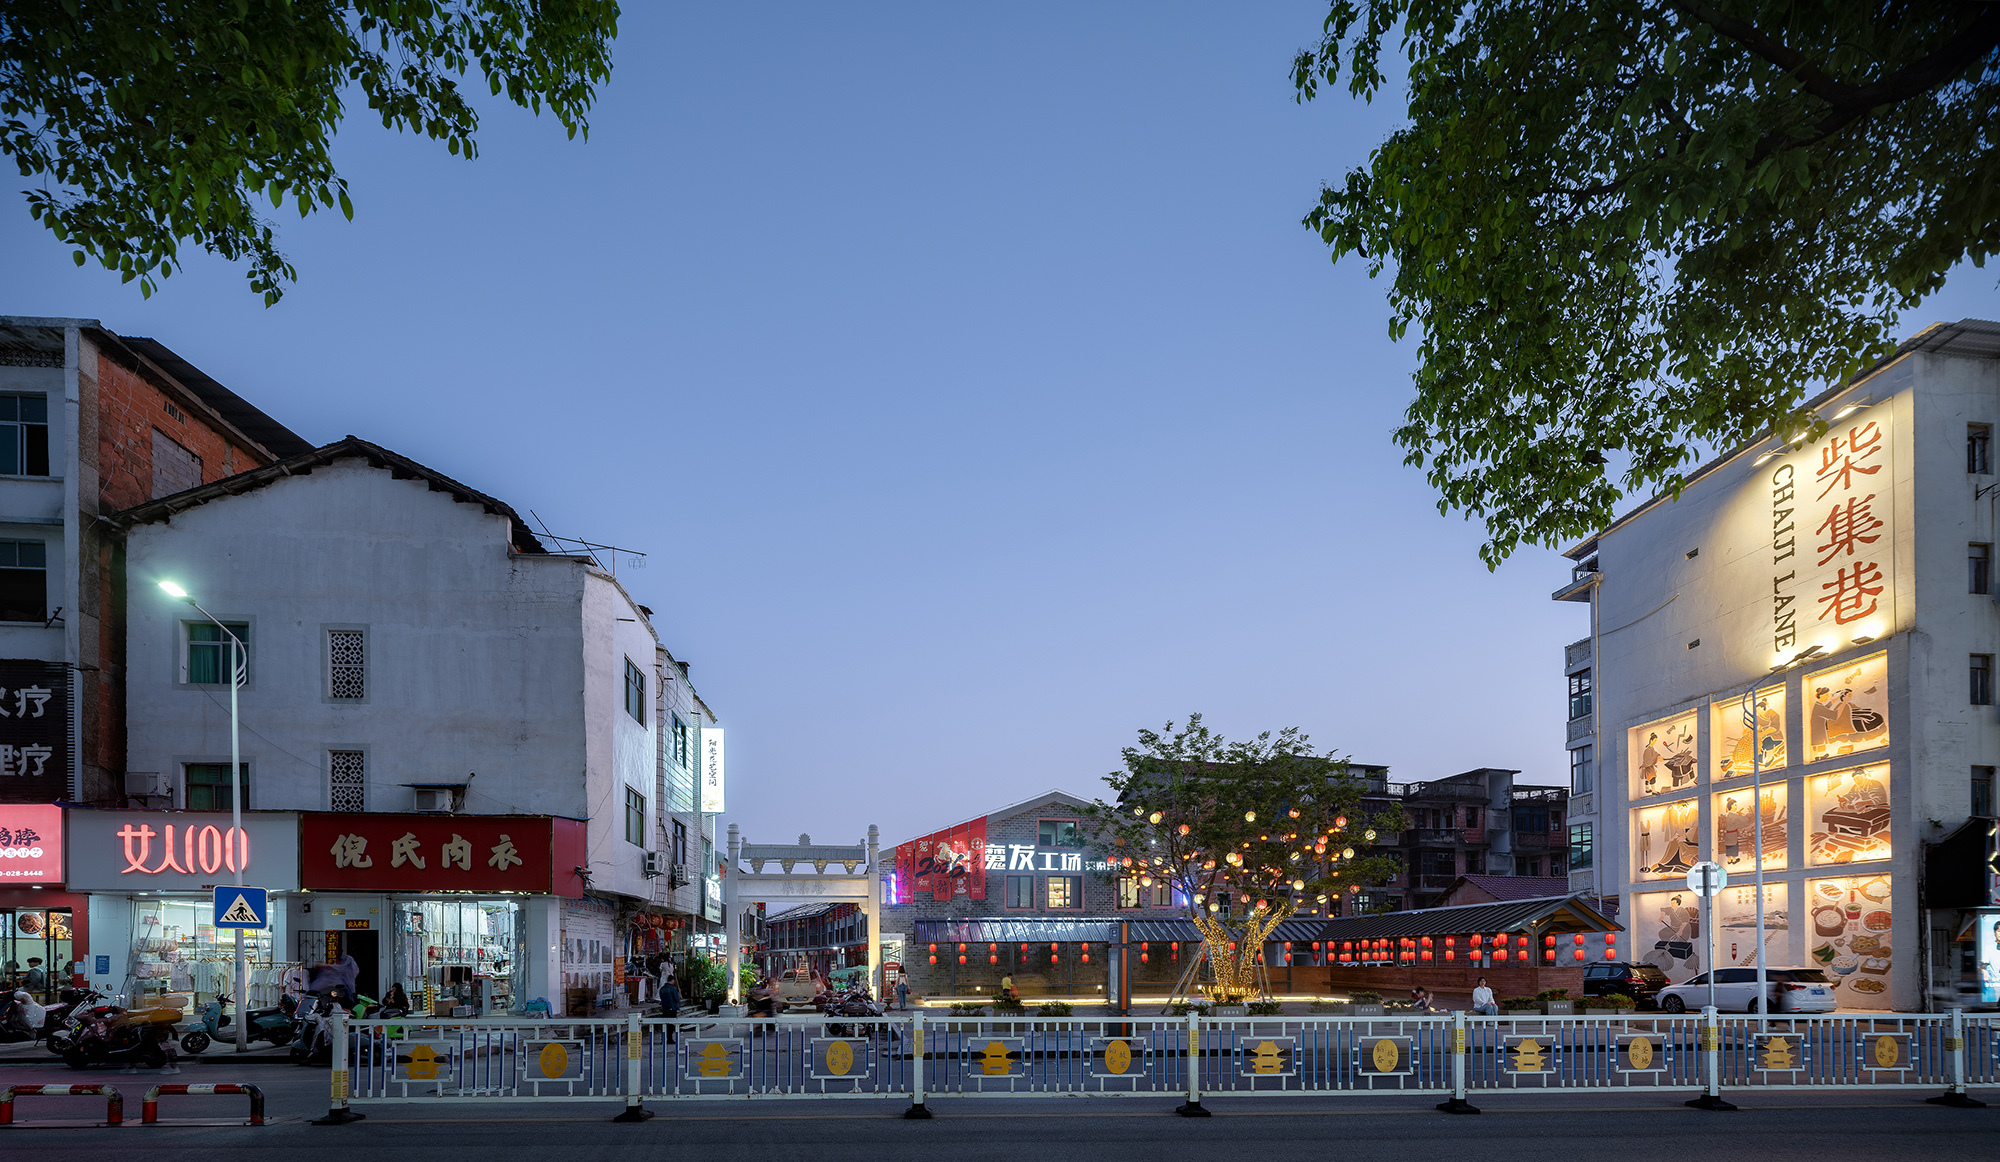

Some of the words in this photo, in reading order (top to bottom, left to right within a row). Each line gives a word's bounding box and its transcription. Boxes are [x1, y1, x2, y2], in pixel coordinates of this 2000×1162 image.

[1772, 463, 1796, 566] CHAIJI
[1815, 421, 1884, 625] 柴集巷
[1773, 569, 1797, 653] LANE
[330, 832, 523, 871] 倪氏内衣
[915, 854, 967, 878] 2026
